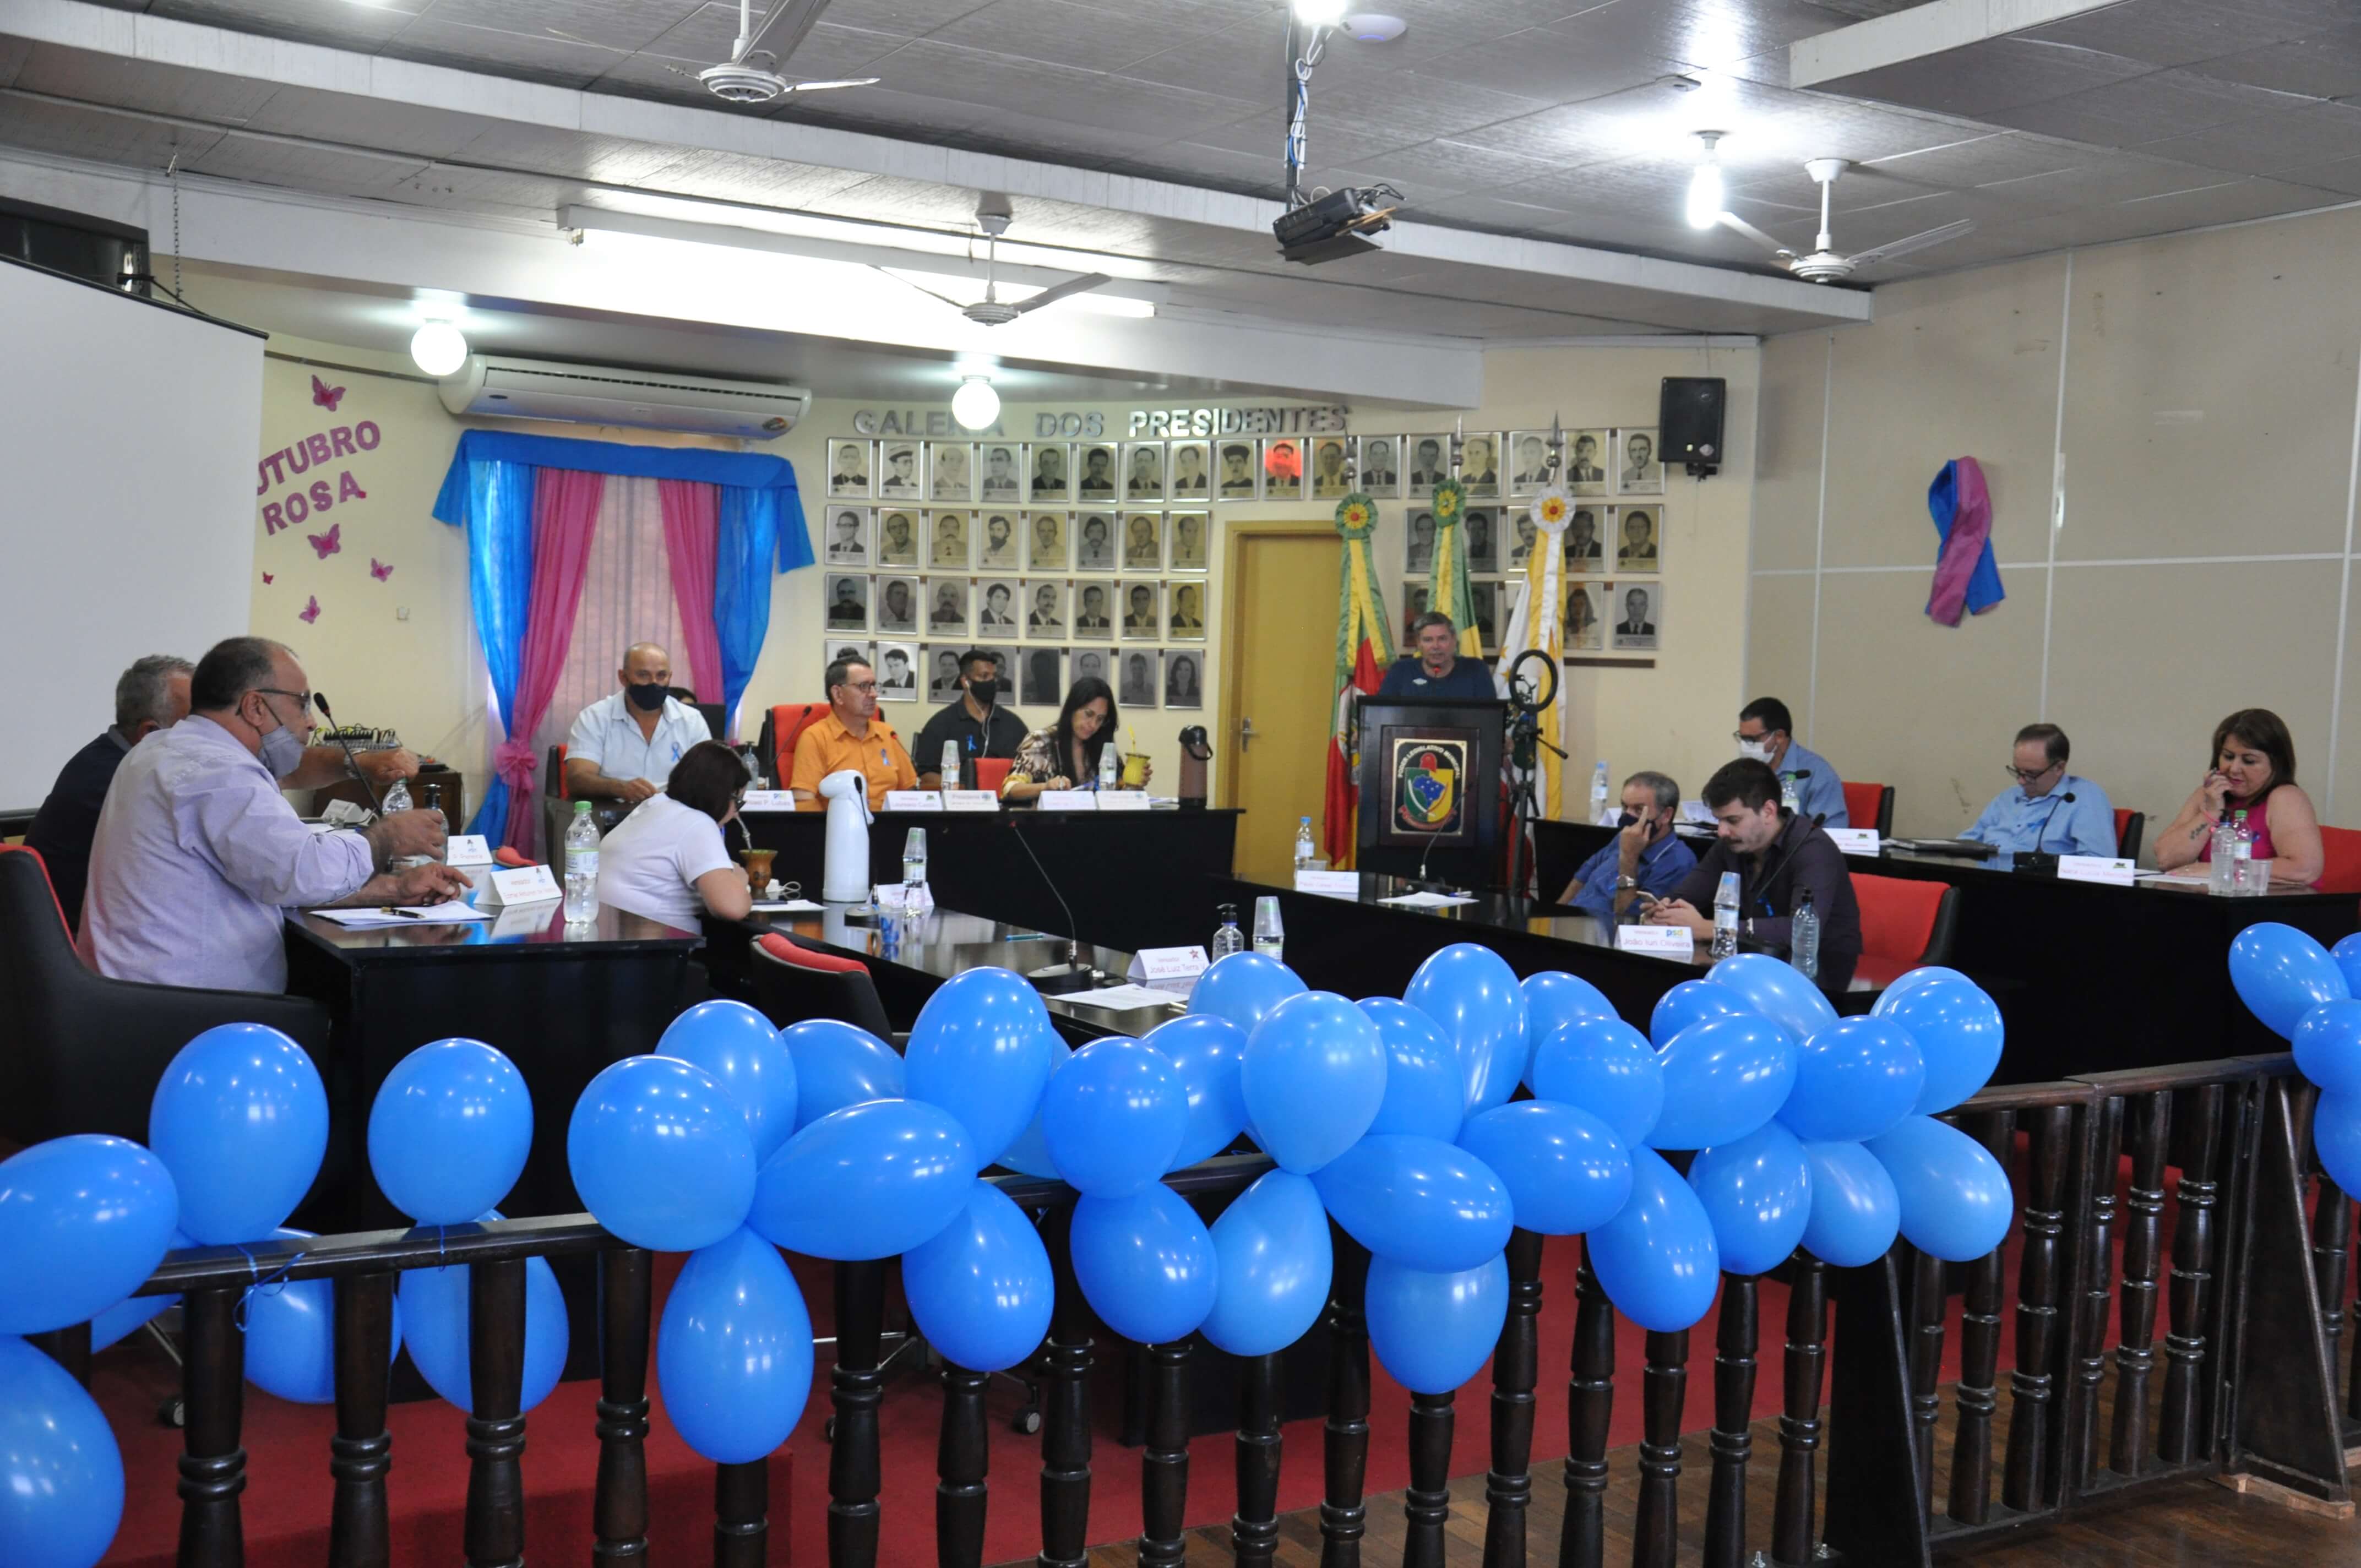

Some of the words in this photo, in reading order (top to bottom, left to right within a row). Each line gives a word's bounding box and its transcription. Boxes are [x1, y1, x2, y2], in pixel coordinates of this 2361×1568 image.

[853, 410, 1004, 437] GALEA
[1035, 411, 1105, 437] DOS
[1129, 405, 1349, 438] PRESIDENTES
[262, 471, 361, 536] ROSA
[1397, 756, 1407, 778] PODER
[1406, 744, 1444, 758] LEGISLATIVO
[1443, 750, 1461, 779] MUNICIPAL
[1150, 964, 1166, 973] José
[1167, 965, 1181, 973] Luiz
[1182, 963, 1199, 971] Terra
